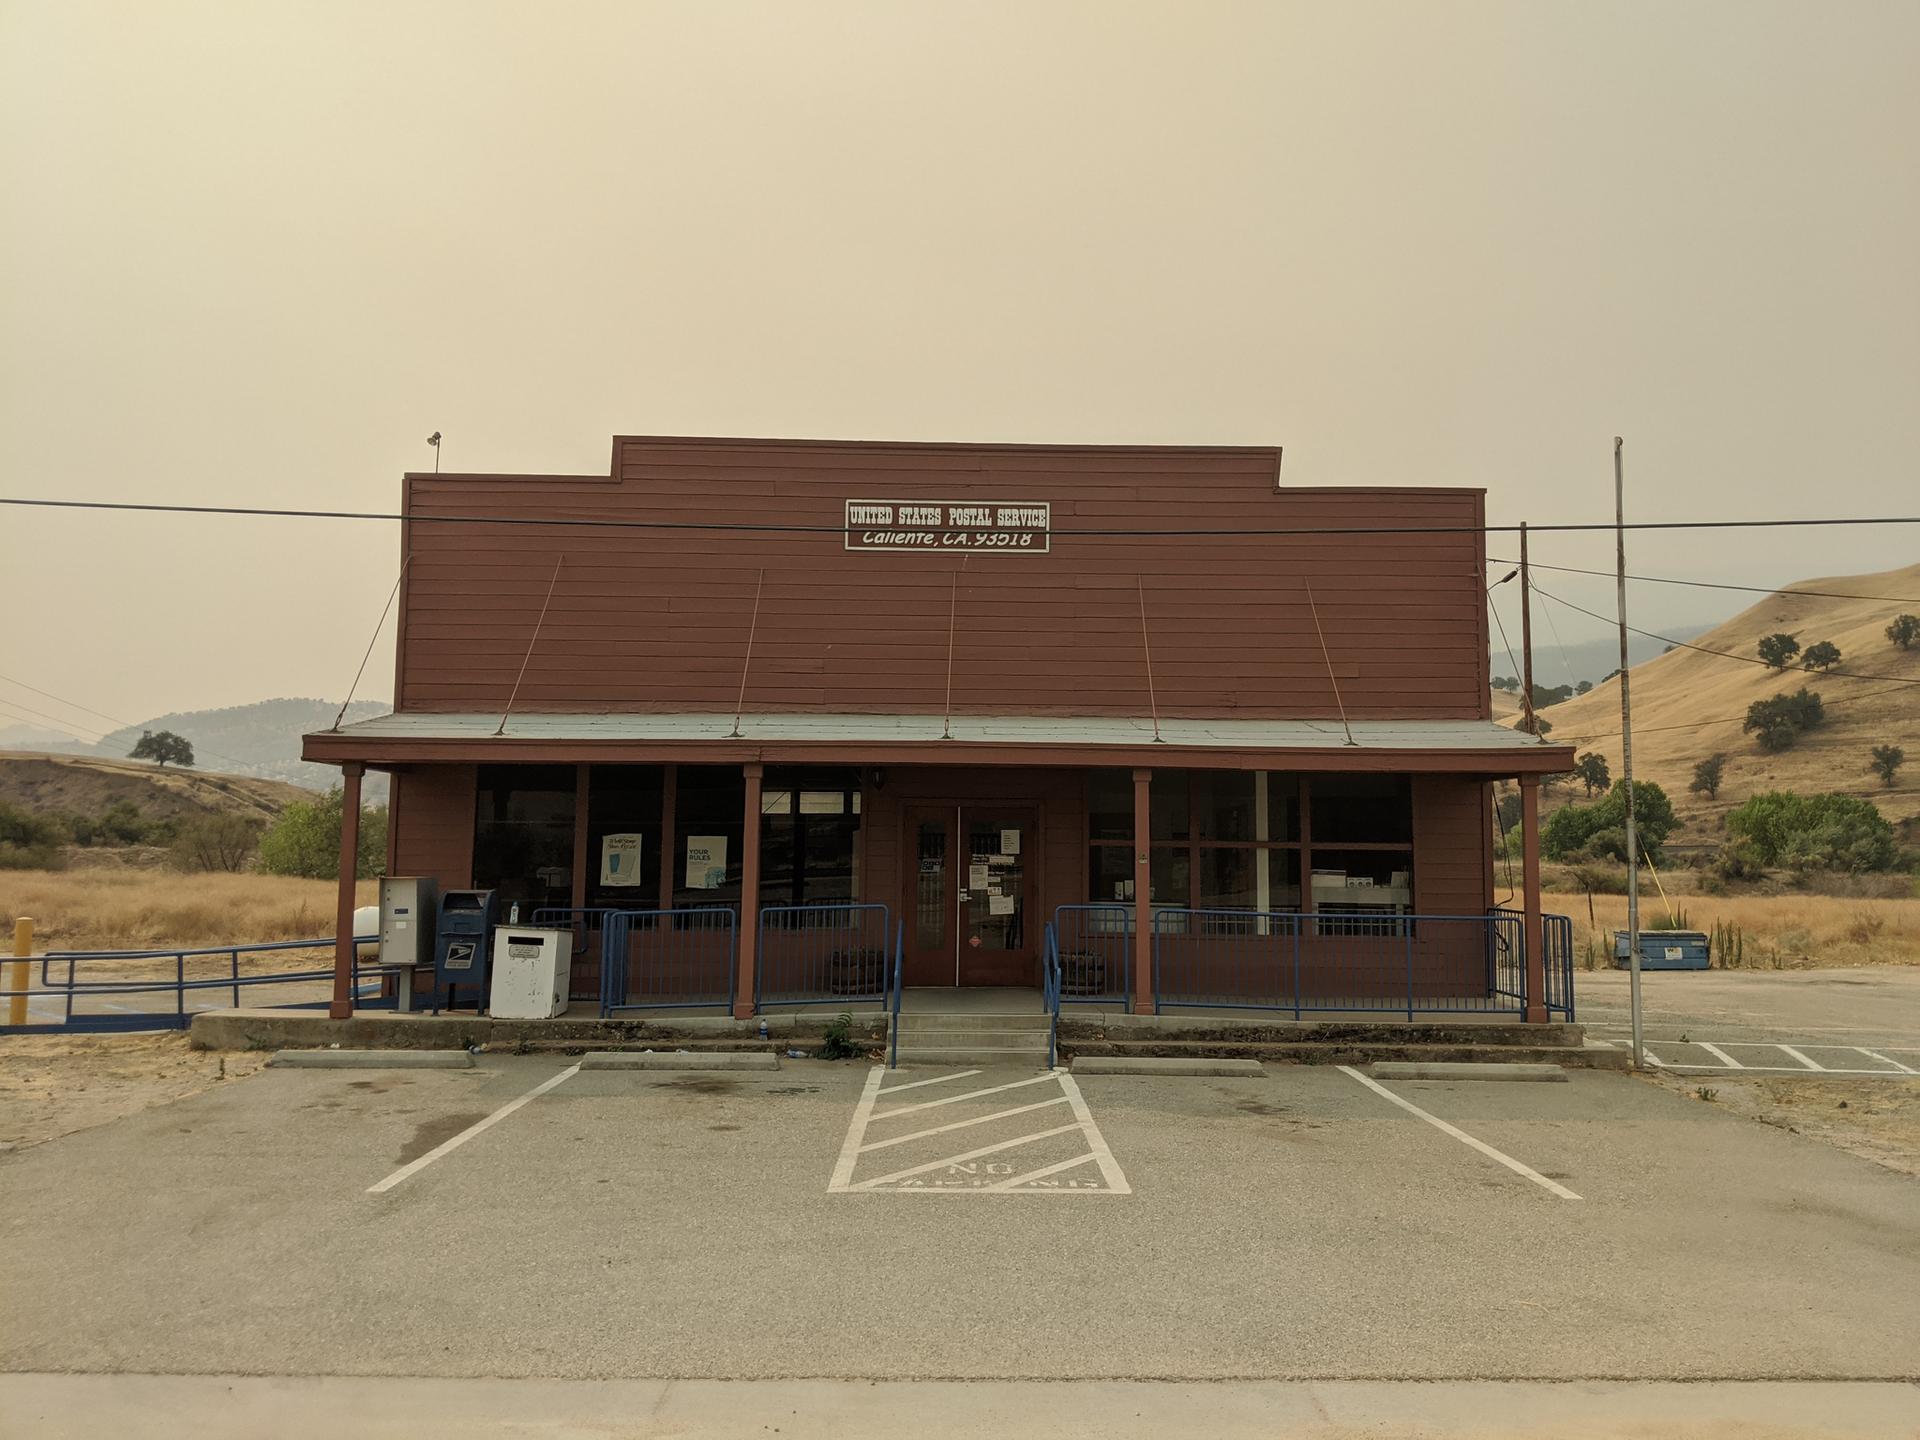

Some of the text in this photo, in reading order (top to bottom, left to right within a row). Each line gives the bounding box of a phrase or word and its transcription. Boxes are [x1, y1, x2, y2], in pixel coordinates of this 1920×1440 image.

[850, 506, 1046, 527] UNITED STATES POSTAL SERVICE
[949, 1162, 1014, 1174] NO
